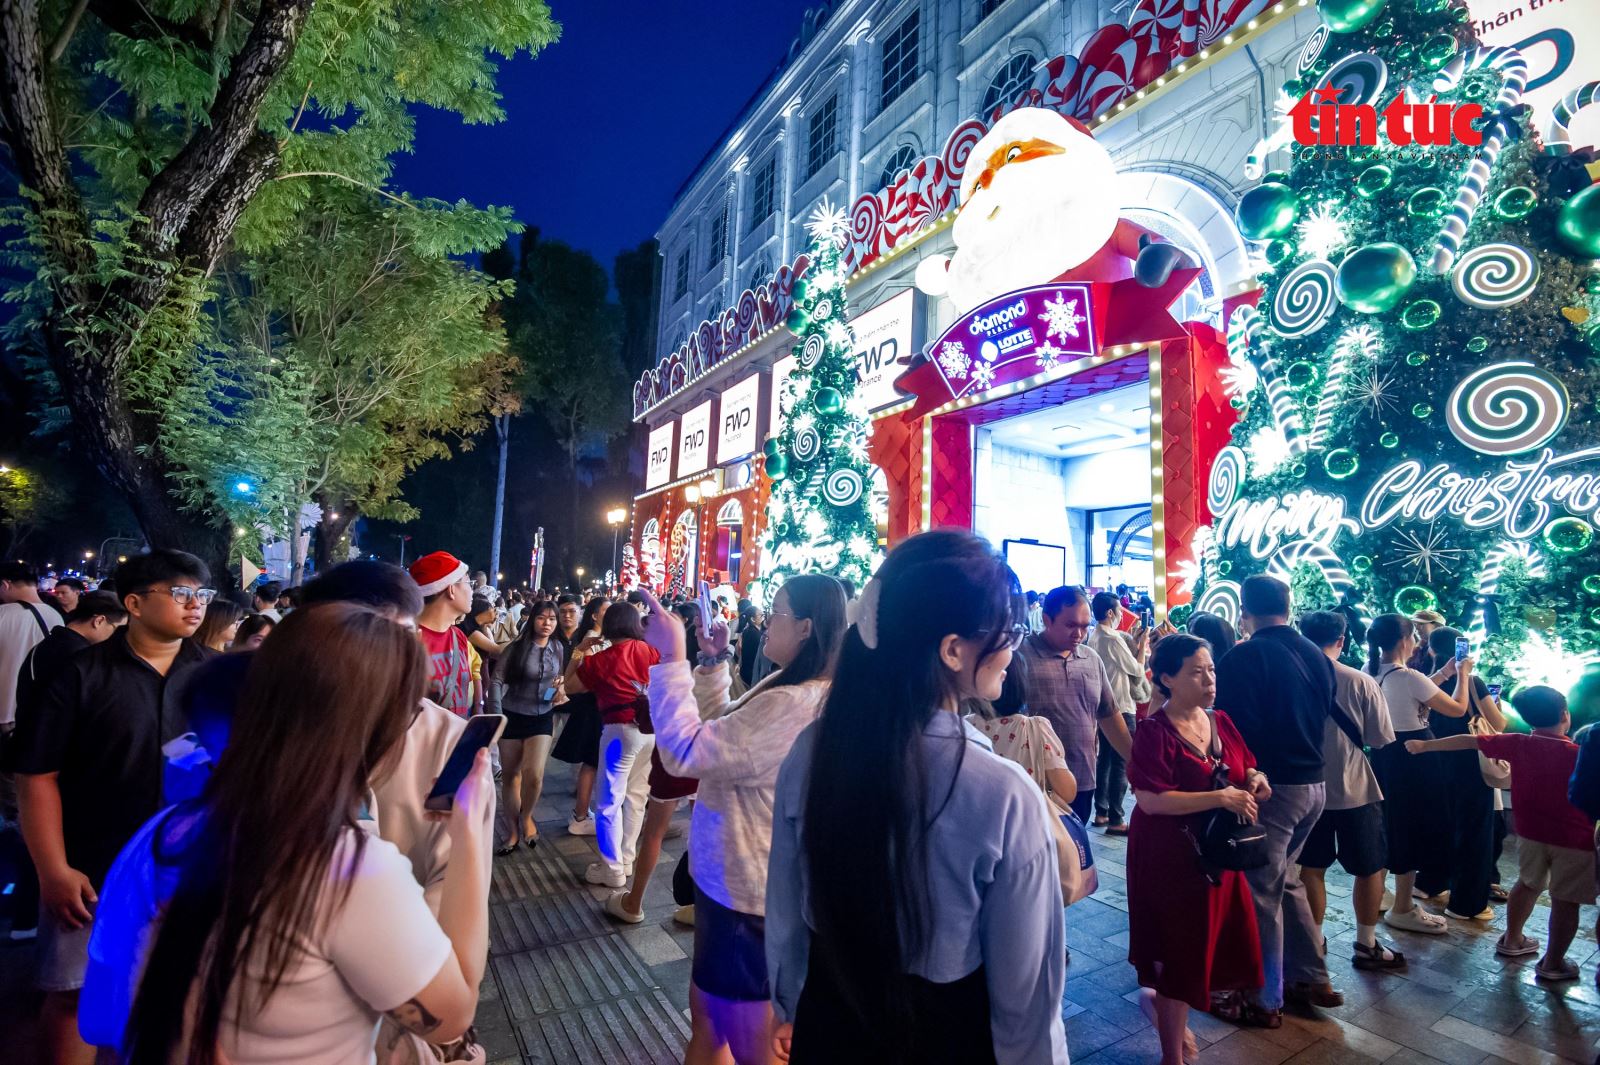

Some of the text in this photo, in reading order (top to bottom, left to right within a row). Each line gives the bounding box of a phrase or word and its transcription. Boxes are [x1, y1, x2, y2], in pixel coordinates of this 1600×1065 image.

[969, 299, 1026, 336] diamond
[986, 321, 1015, 337] PLAZA
[998, 329, 1032, 350] LOTTE
[724, 406, 751, 436] FWD
[683, 429, 705, 453] FWD
[650, 446, 668, 467] FWD
[1215, 489, 1360, 559] Merry
